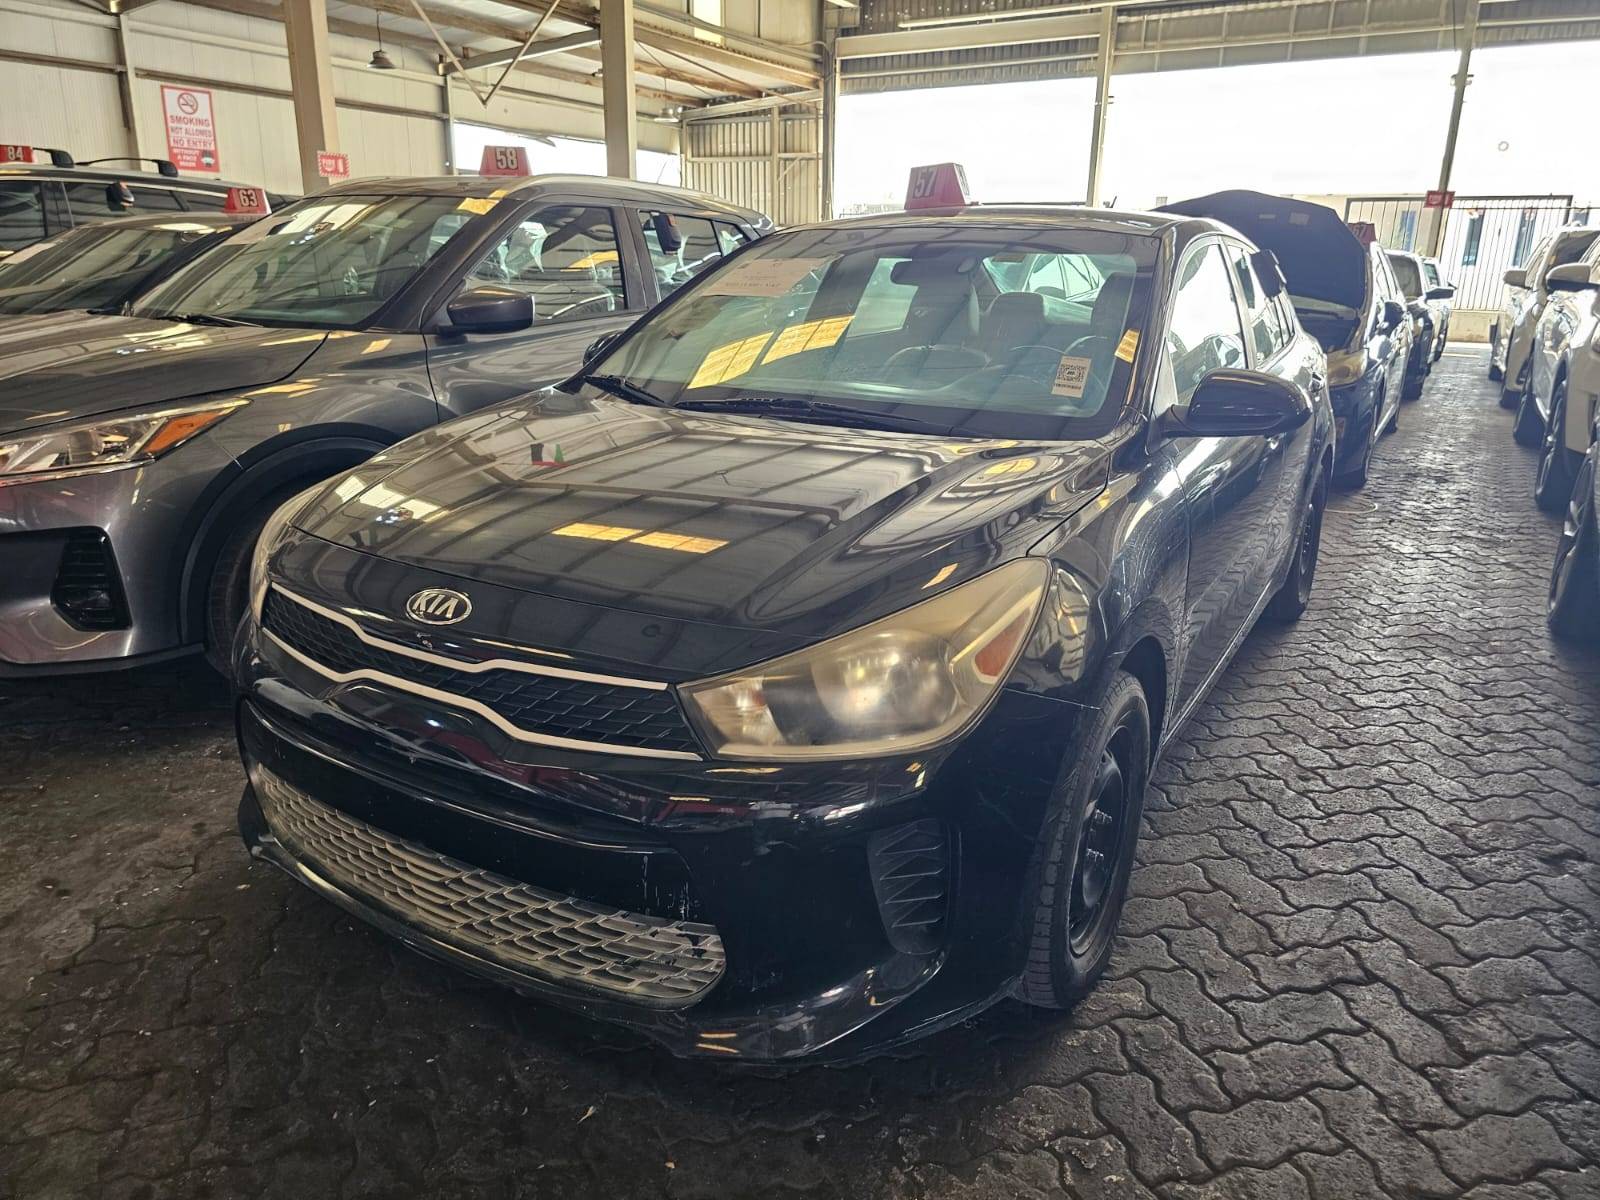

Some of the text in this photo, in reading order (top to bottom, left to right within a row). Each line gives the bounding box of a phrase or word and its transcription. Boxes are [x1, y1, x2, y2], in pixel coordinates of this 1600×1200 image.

[169, 115, 210, 127] SMOKING
[171, 127, 212, 138] NOT ALLOWED
[173, 137, 213, 148] NO ENTRY
[8, 146, 24, 160] 84
[495, 147, 518, 169] 58
[914, 168, 937, 198] 57
[239, 189, 258, 207] 63
[412, 591, 459, 619] KIA
